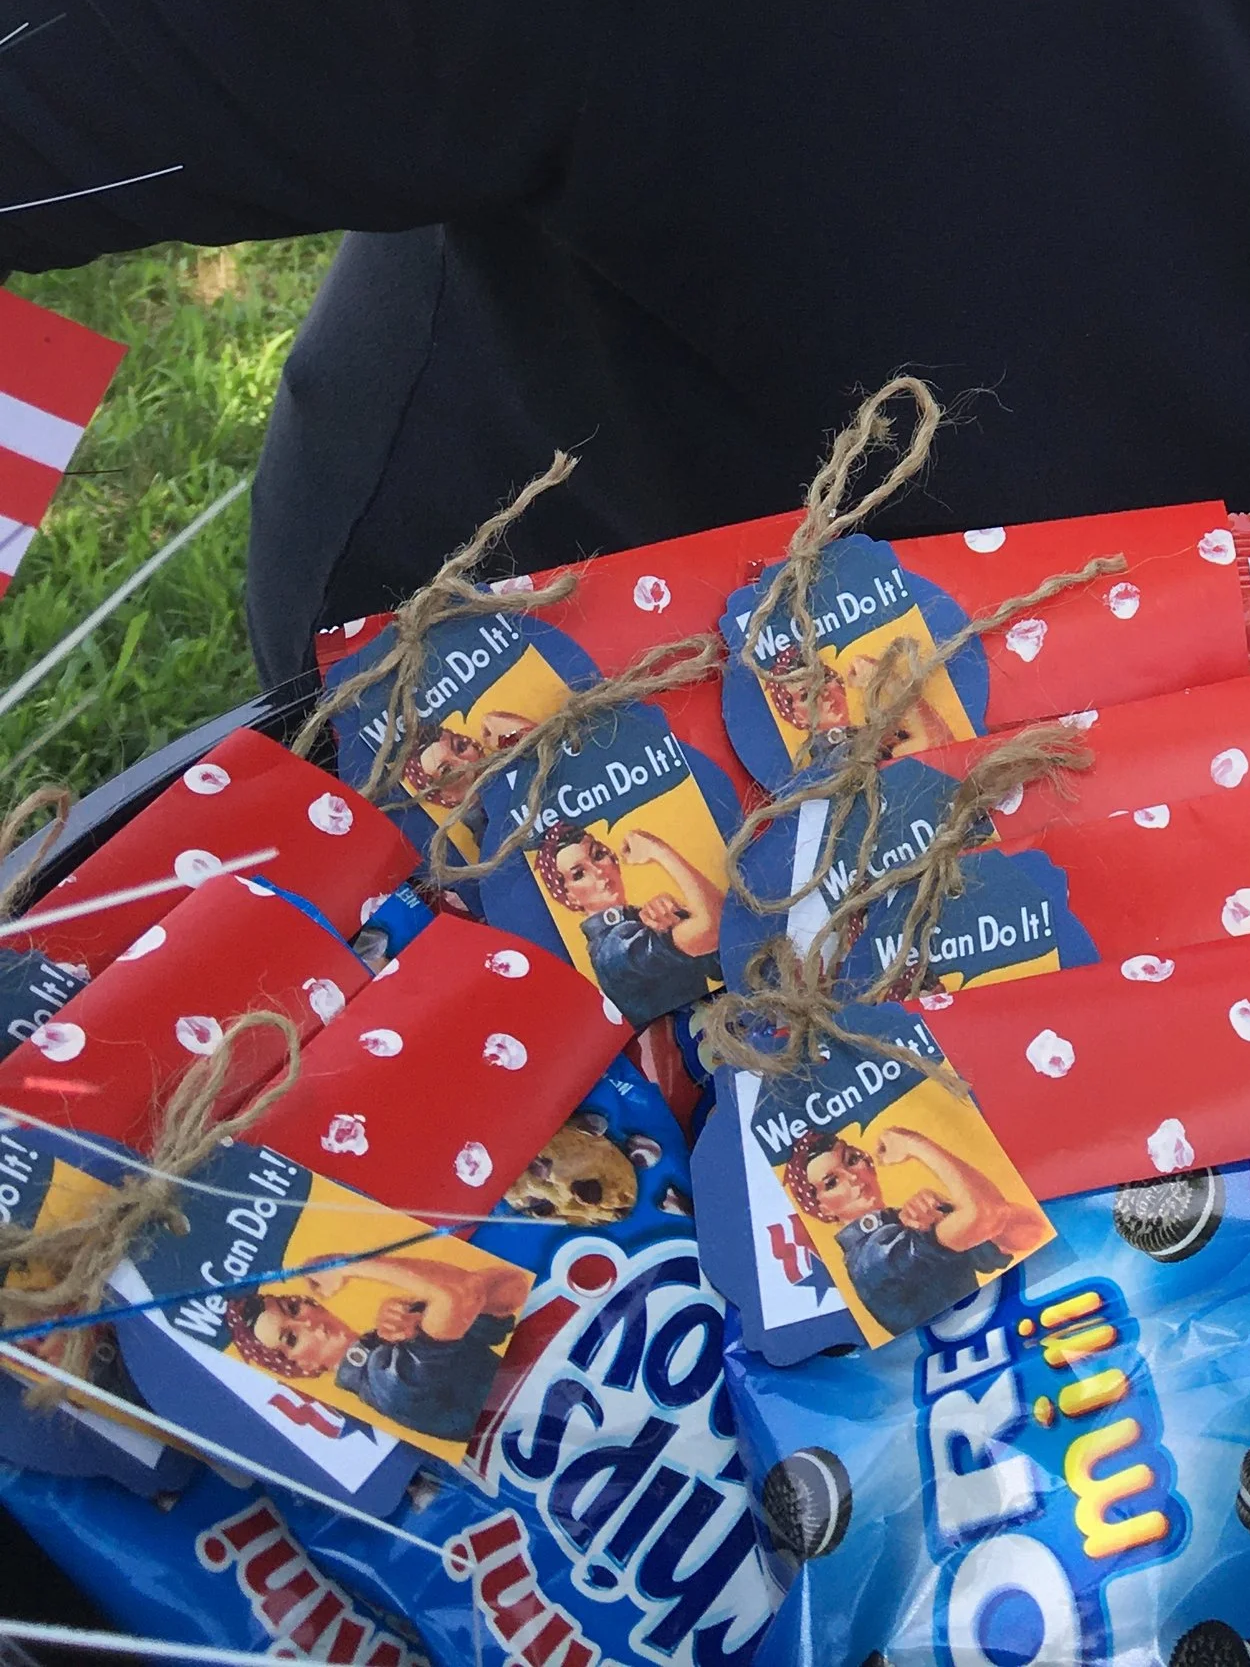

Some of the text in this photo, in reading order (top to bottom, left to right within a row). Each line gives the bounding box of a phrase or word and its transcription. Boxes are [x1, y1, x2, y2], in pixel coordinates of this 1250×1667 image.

[445, 648, 491, 684] Do
[478, 612, 520, 655] It!
[746, 625, 791, 661] We
[836, 591, 877, 624] Do
[873, 568, 909, 607] It!
[510, 735, 682, 838] We Can Do It!
[910, 819, 941, 853] D
[875, 901, 1052, 973] We Can Do It!
[29, 963, 75, 1008] It!
[755, 1111, 808, 1154] We
[805, 1086, 863, 1126] Can
[855, 1060, 901, 1096] Do
[174, 1150, 298, 1338] We Can Do It!
[1018, 1291, 1171, 1560] mini
